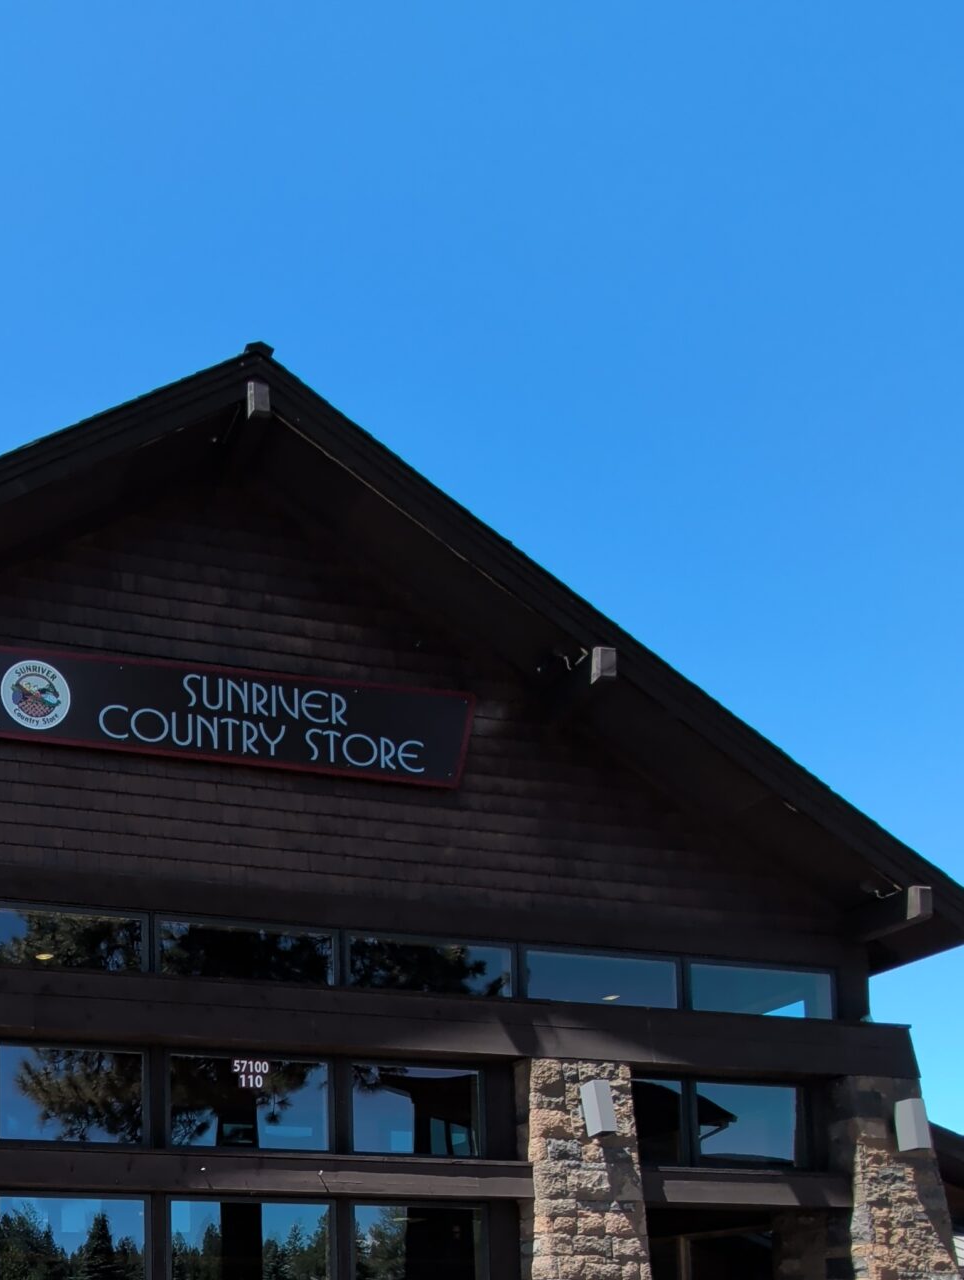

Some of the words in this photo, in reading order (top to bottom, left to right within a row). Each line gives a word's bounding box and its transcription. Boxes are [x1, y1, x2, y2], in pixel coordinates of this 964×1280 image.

[15, 665, 57, 681] SUNRIVER
[183, 674, 348, 726] SUNRIVER
[14, 708, 40, 726] Country
[42, 713, 59, 725] Store
[98, 704, 286, 756] COUNTRY
[305, 728, 425, 773] STORE
[233, 1060, 269, 1073] 57100
[239, 1074, 263, 1088] 110
